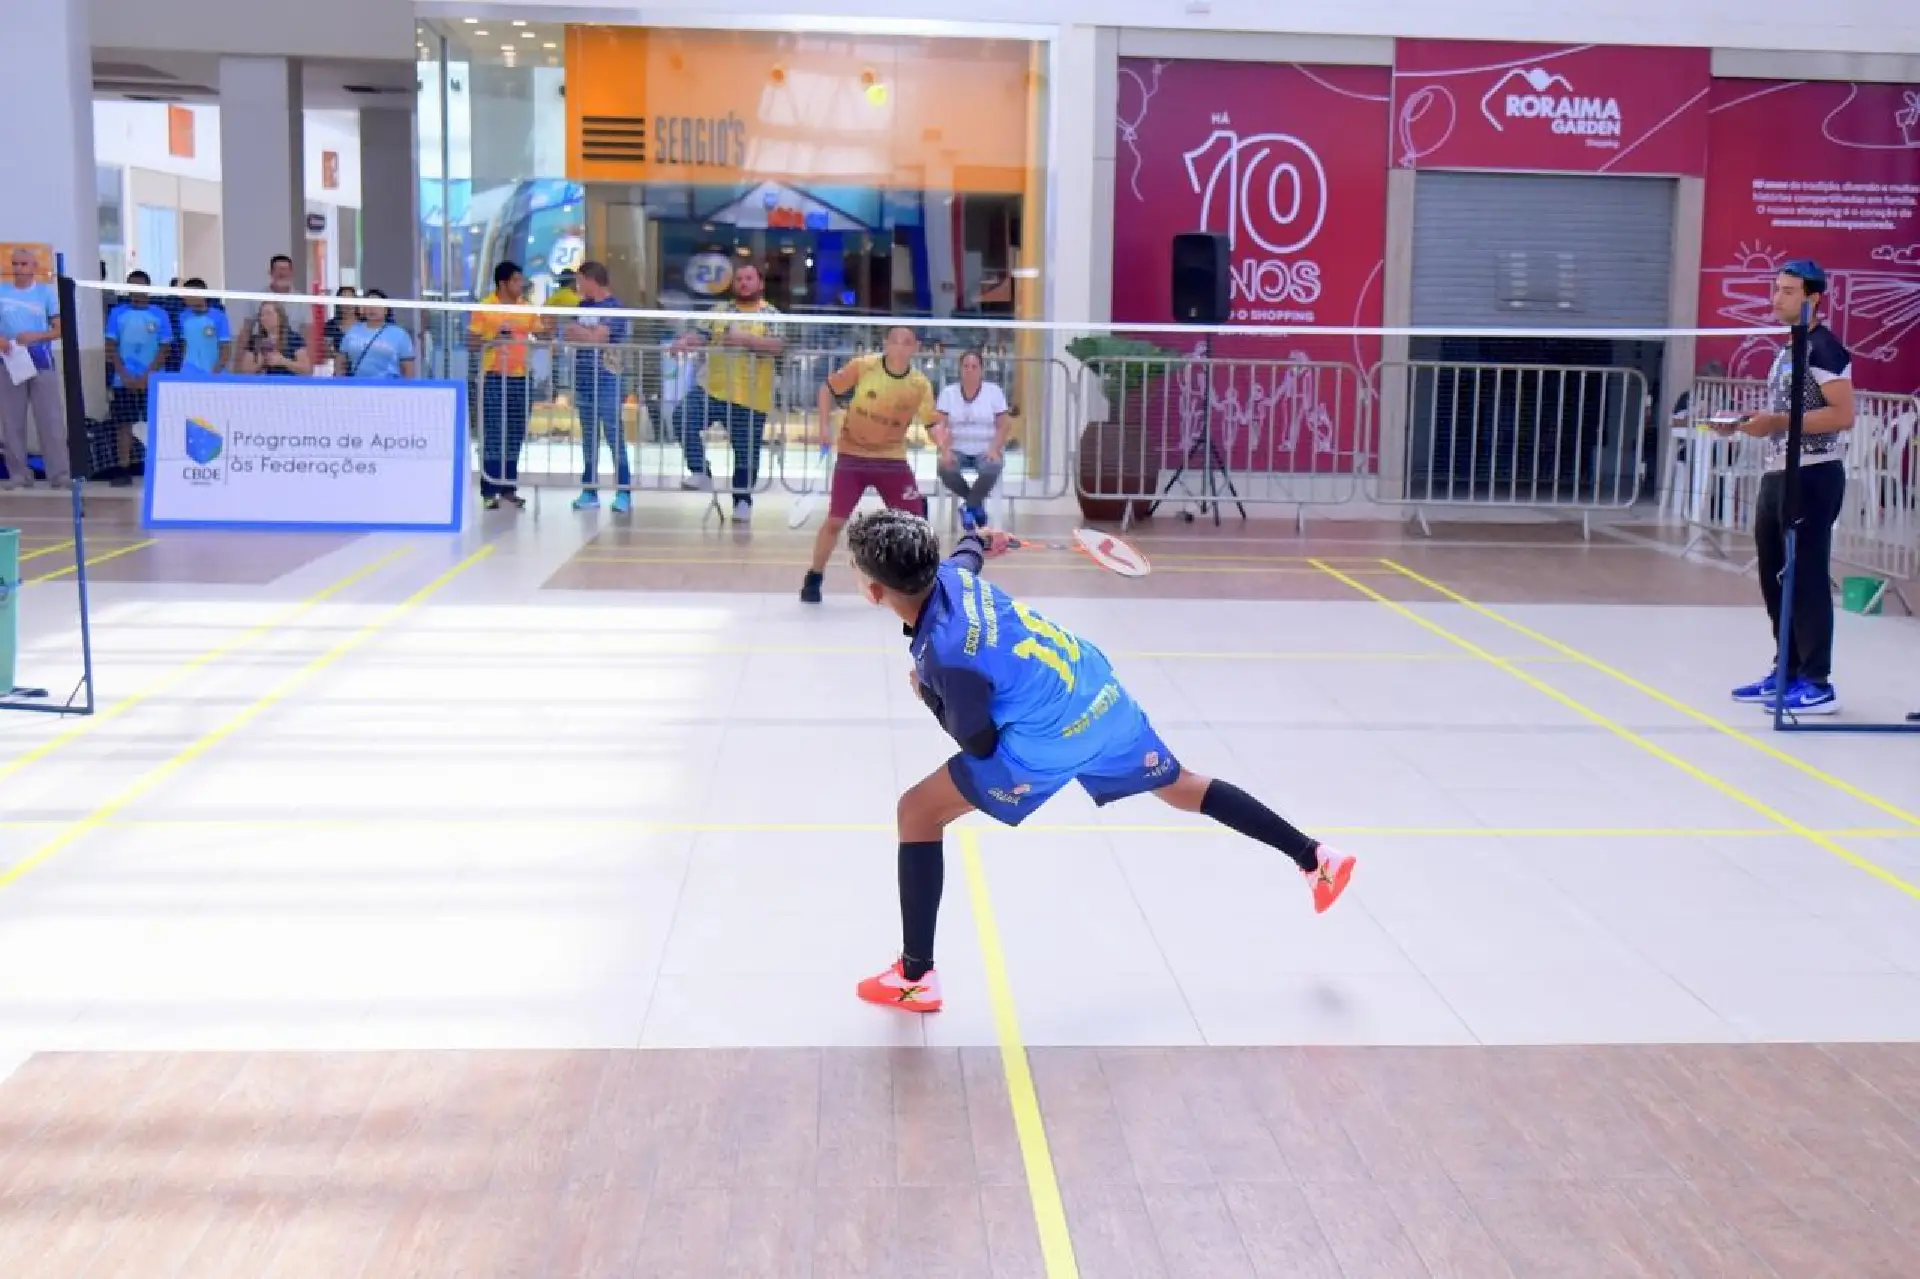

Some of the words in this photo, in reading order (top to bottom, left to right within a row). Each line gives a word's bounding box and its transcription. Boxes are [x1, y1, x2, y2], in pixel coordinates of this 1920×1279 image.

[1506, 94, 1621, 119] RORAIMA
[1551, 118, 1621, 136] GARDEN
[655, 111, 745, 167] SERGIO'S
[1183, 130, 1327, 254] 10
[1230, 259, 1321, 303] NOS
[1251, 309, 1315, 323] SHOPPING
[233, 431, 331, 451] Programa
[336, 433, 363, 449] de
[371, 433, 427, 450] Apoio
[182, 467, 221, 481] CBDE
[230, 456, 253, 473] às
[261, 457, 377, 479] Federações
